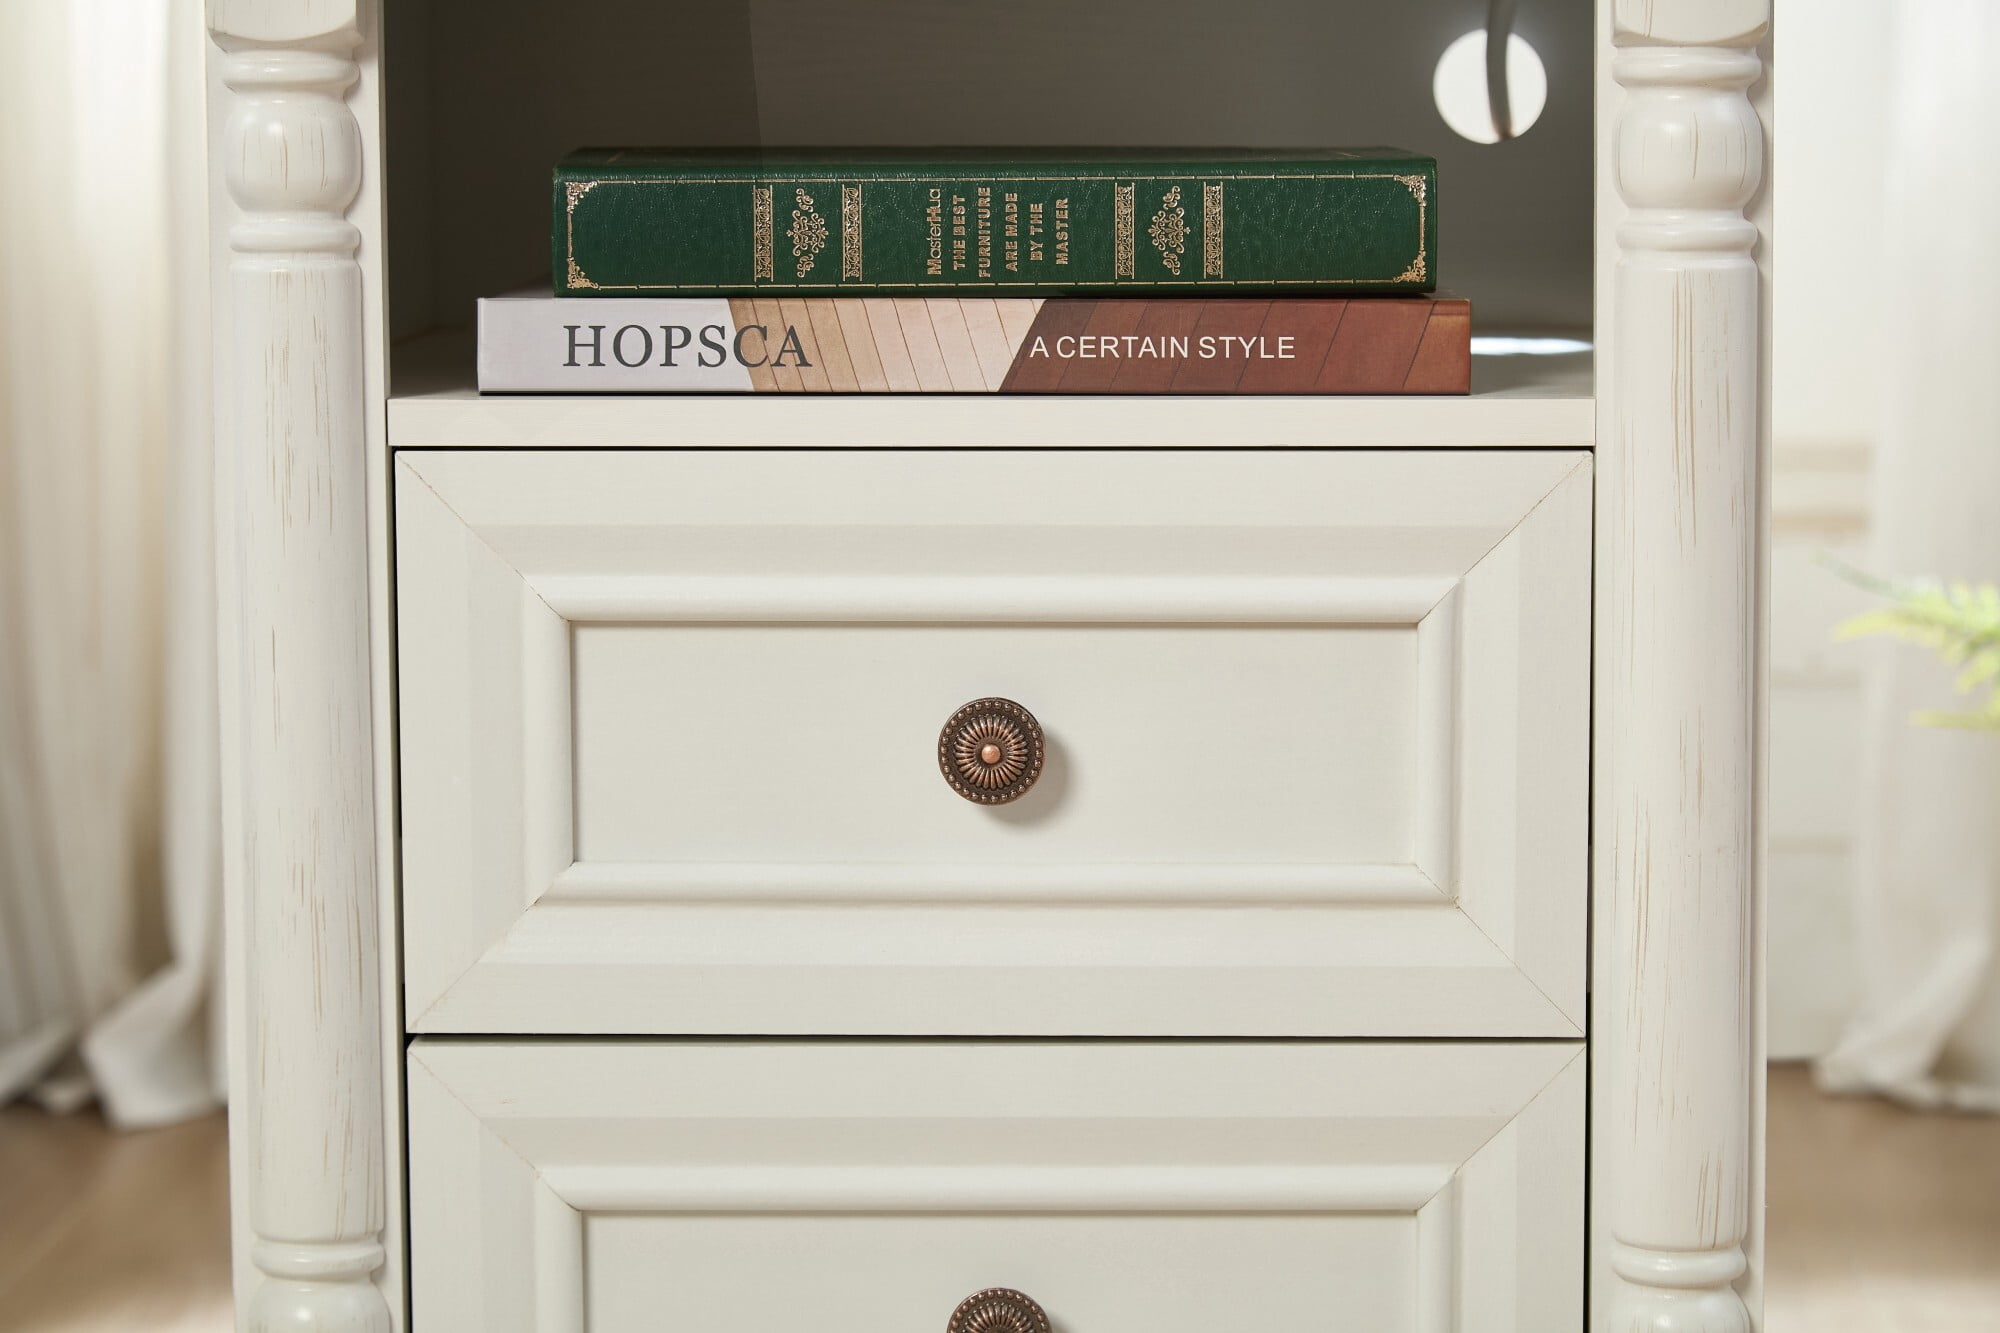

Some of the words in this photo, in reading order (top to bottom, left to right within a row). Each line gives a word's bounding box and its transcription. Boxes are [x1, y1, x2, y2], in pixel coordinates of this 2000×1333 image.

[926, 188, 942, 276] MasterHua
[953, 194, 966, 236] BEST
[978, 186, 991, 278] FURNITURE
[1005, 192, 1018, 237] MADE
[1030, 202, 1043, 236] THE
[1055, 197, 1069, 265] MASTER
[953, 239, 966, 271] THE
[1005, 240, 1018, 272] ARE
[1030, 240, 1043, 261] BY
[562, 324, 813, 368] HOPSCA
[1029, 336, 1050, 359] A
[1056, 335, 1189, 359] CERTAIN
[1198, 335, 1295, 360] STYLE
